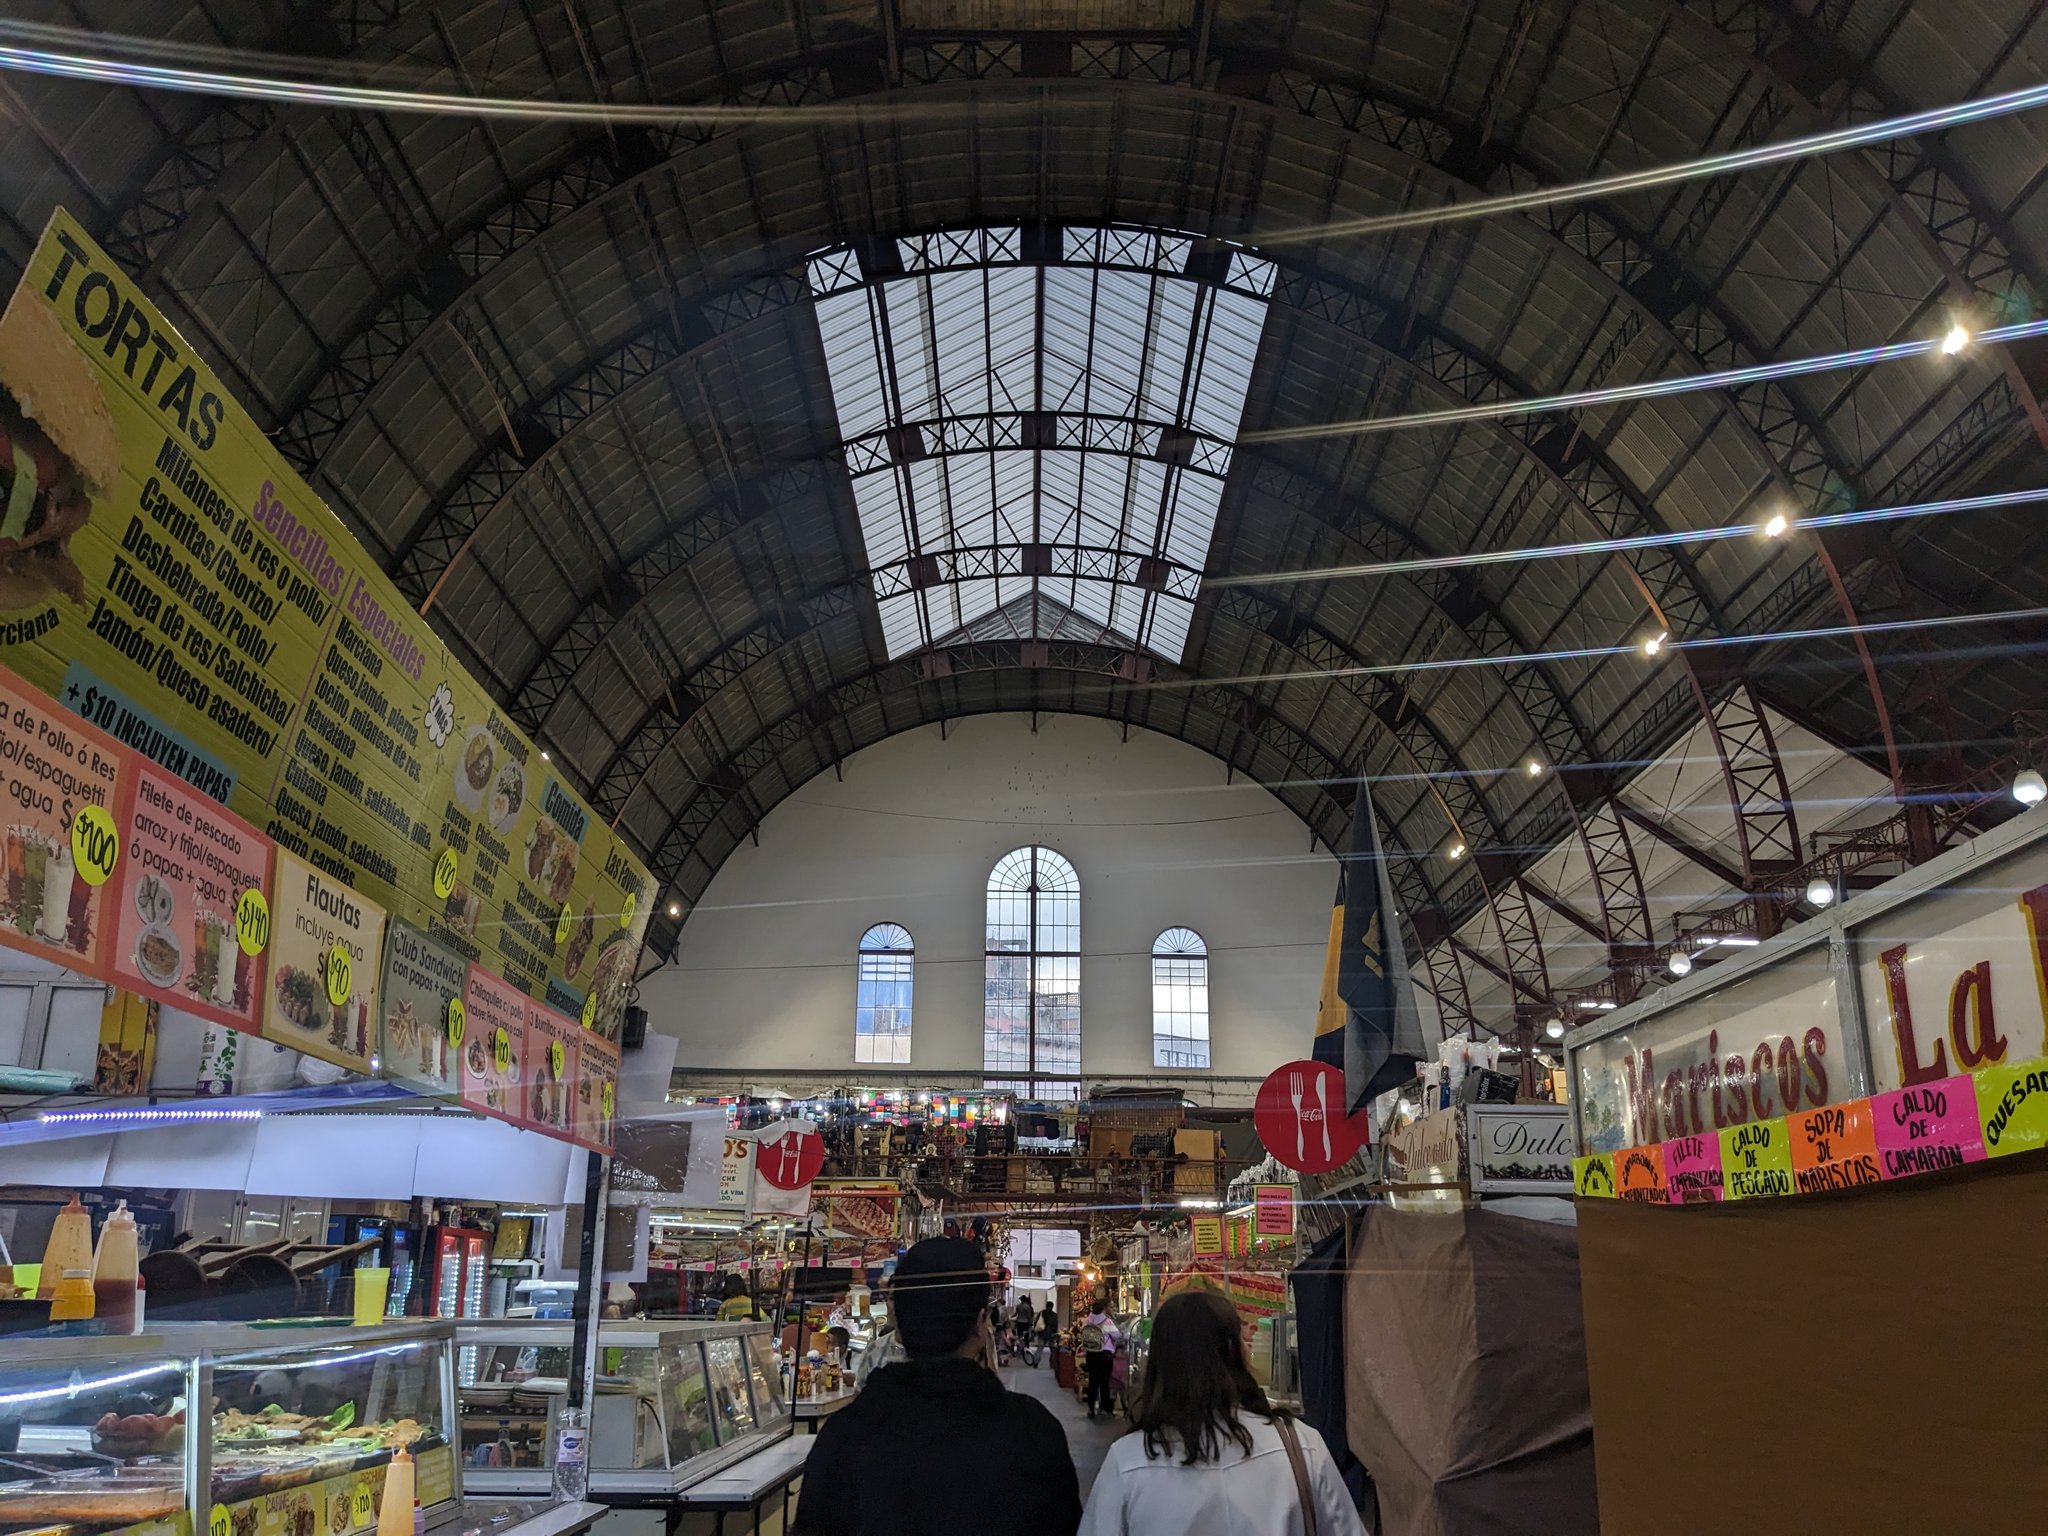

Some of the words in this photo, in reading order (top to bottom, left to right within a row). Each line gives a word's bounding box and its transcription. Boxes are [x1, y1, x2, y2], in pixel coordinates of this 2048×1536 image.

[45, 229, 224, 451] TORTAS
[155, 436, 234, 537] Milanesa
[231, 517, 253, 554] de
[249, 540, 276, 582] res
[277, 566, 290, 590] o
[253, 479, 345, 598] Sencillas
[105, 554, 160, 625] Tinga
[159, 603, 186, 643] de
[336, 615, 383, 679] Marciana
[347, 576, 425, 682] Especiales
[87, 597, 210, 711] Jamón/Queso
[13, 709, 35, 734] de
[39, 720, 73, 757] Pollo
[91, 752, 116, 783] Res
[67, 683, 79, 700] +
[81, 686, 117, 732] $10
[113, 707, 191, 776] INCLUYEN
[184, 762, 232, 804] PAPAS
[304, 699, 356, 760] Hawaiana
[285, 757, 327, 806] Cubana
[9, 779, 53, 815] agua
[60, 799, 73, 834] $
[140, 780, 174, 815] Filete
[176, 804, 192, 825] de
[194, 816, 241, 856] pescado
[445, 800, 471, 835] Huevos
[545, 781, 585, 843] Comida
[76, 812, 115, 877] $100
[135, 813, 168, 840] arroz
[169, 834, 178, 851] y
[143, 849, 184, 884] papas
[197, 877, 226, 905] agua
[605, 846, 621, 880] Las
[239, 898, 267, 947] $140
[306, 873, 361, 930] Flautas
[295, 908, 334, 947] incluye
[317, 952, 324, 978] $
[329, 951, 349, 995] $90
[393, 960, 408, 979] con
[409, 969, 433, 992] papas
[394, 931, 418, 963] Club
[419, 945, 463, 988] Sandwich
[529, 1011, 534, 1027] 3
[1878, 942, 2008, 1088] La
[1624, 1026, 1829, 1146] Mariscos
[1893, 1088, 1946, 1126] CALDO
[1732, 1126, 1769, 1158] CALDO
[1804, 1109, 1844, 1143] SOPA
[1816, 1138, 1831, 1163] DE
[1909, 1118, 1928, 1140] DE
[1623, 1153, 1658, 1187] CAMARONES
[1673, 1137, 1704, 1168] FILETE
[1745, 1149, 1757, 1168] DE
[1796, 1155, 1882, 1193] MARISCOS
[1884, 1140, 1964, 1177] CAMARÓN
[1731, 1168, 1789, 1195] PESCADO
